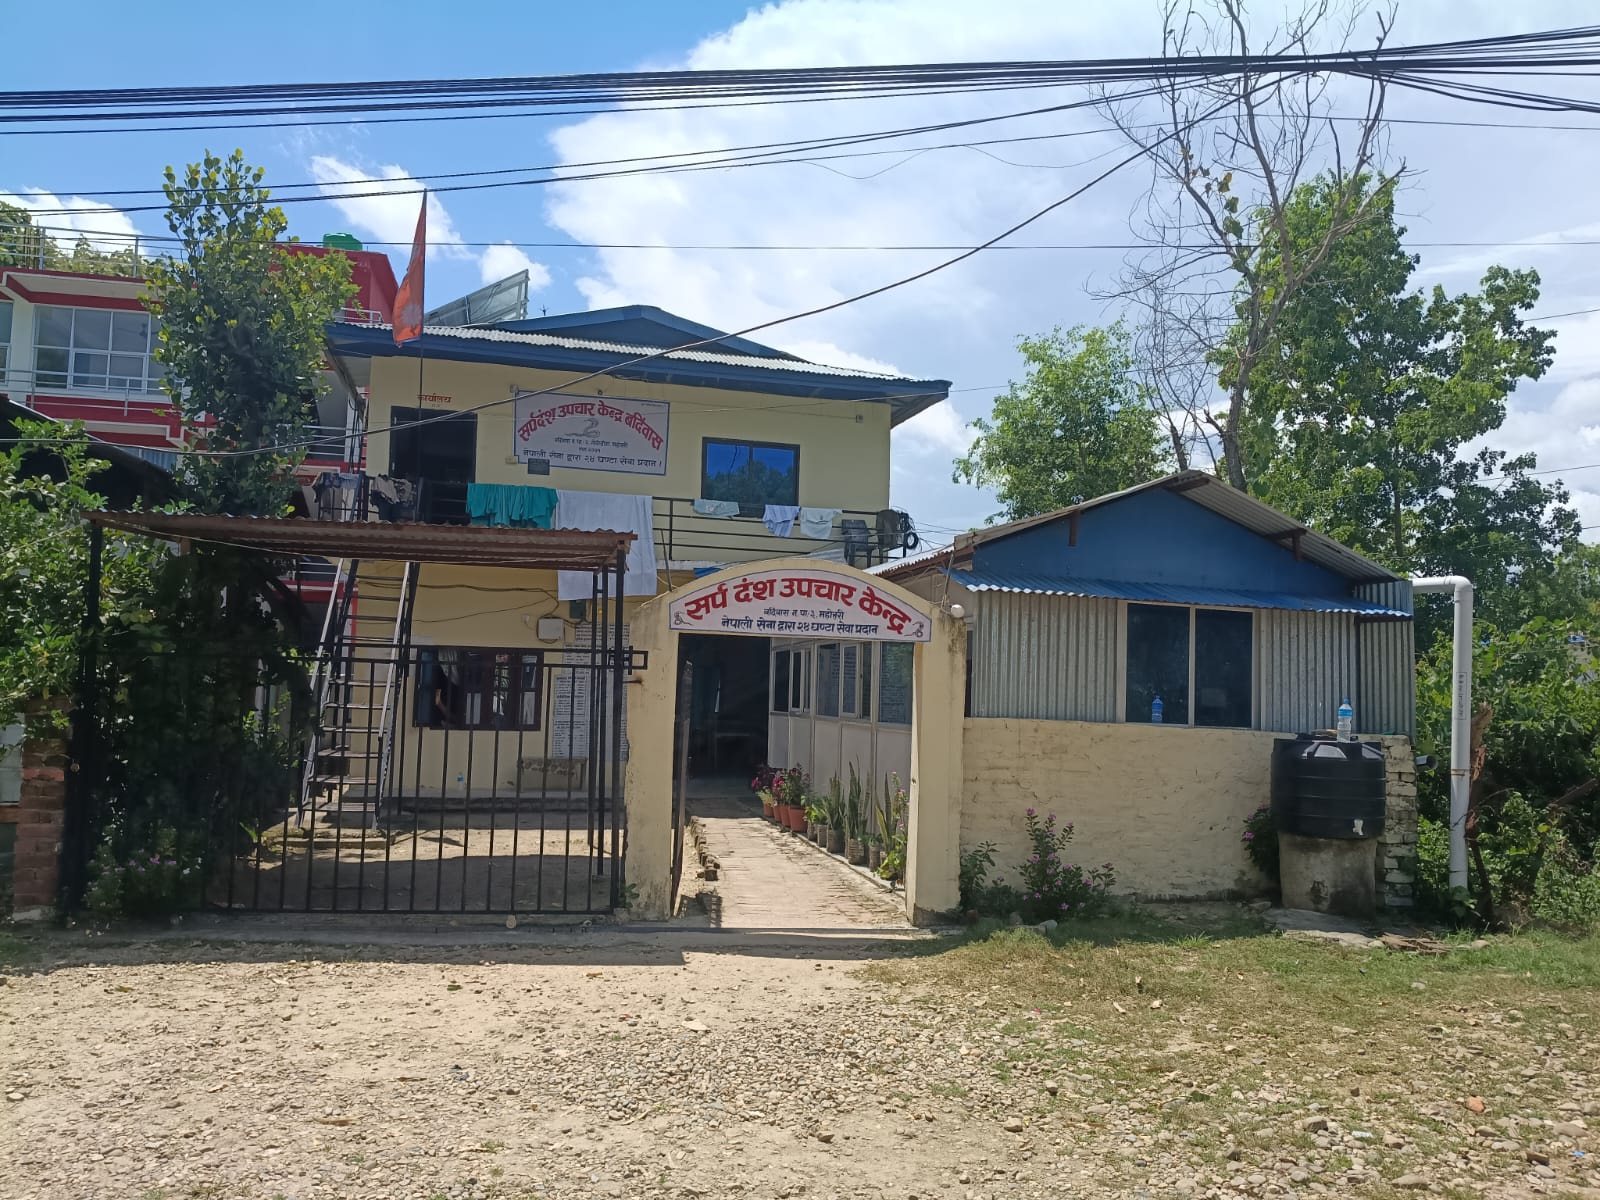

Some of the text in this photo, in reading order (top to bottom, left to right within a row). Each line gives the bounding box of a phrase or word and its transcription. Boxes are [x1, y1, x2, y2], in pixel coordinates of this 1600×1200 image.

[558, 402, 596, 418] उपचार
[598, 400, 625, 423] केन्द्र
[684, 583, 728, 620] सर्प
[733, 577, 776, 602] दंश
[779, 578, 857, 607] उपचार
[721, 615, 879, 636] नेपाली सेना द्वारा २४ घण्टा सेवा प्रदान
